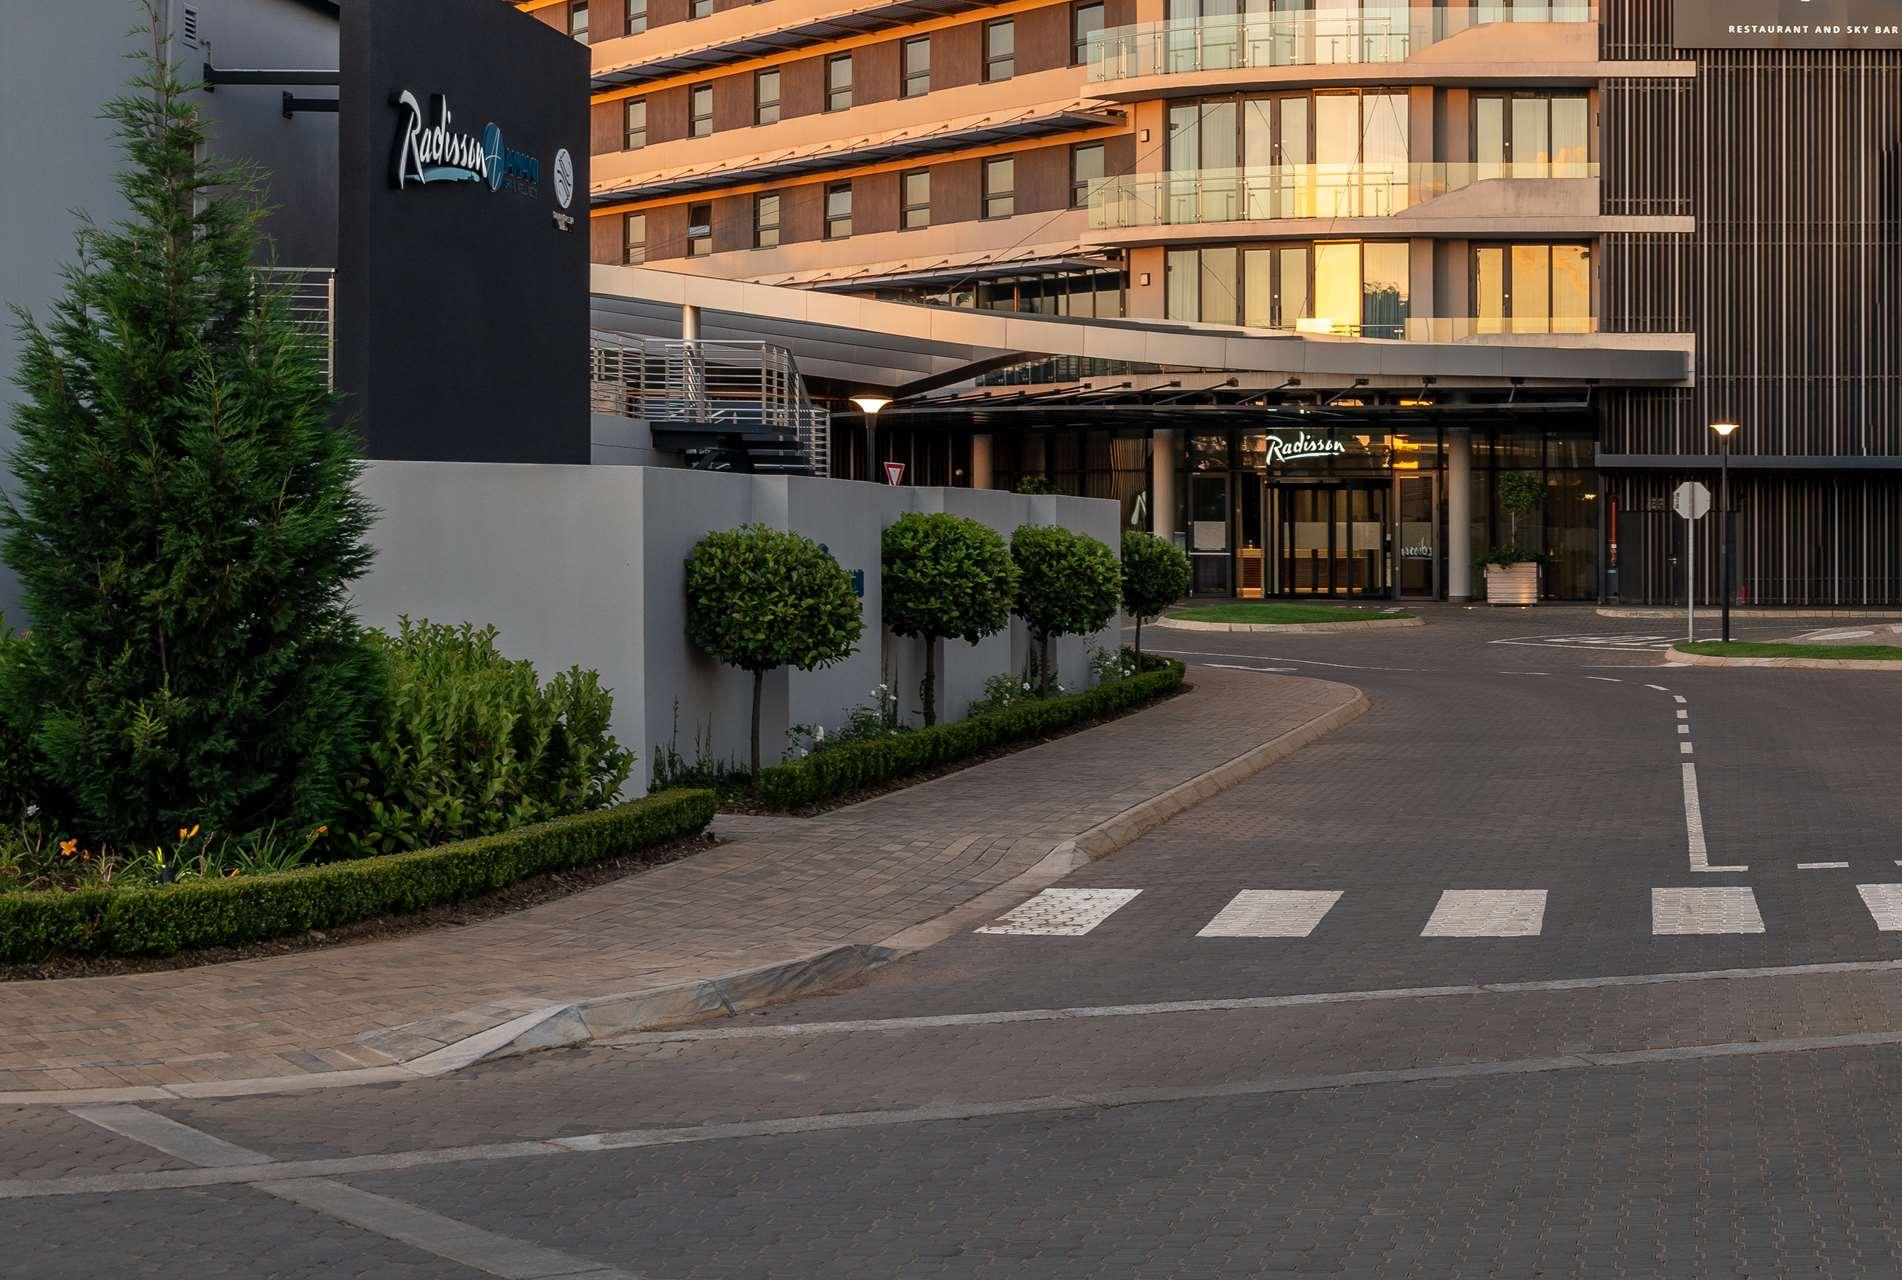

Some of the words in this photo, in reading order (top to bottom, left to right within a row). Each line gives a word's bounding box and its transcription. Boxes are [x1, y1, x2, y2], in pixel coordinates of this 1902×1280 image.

[1728, 25, 1809, 34] RESTAURANT
[1814, 25, 1841, 34] AND
[1846, 25, 1869, 34] SKY
[1874, 26, 1899, 34] BAR
[399, 89, 488, 190] Radisson
[1265, 431, 1345, 466] Radisson
